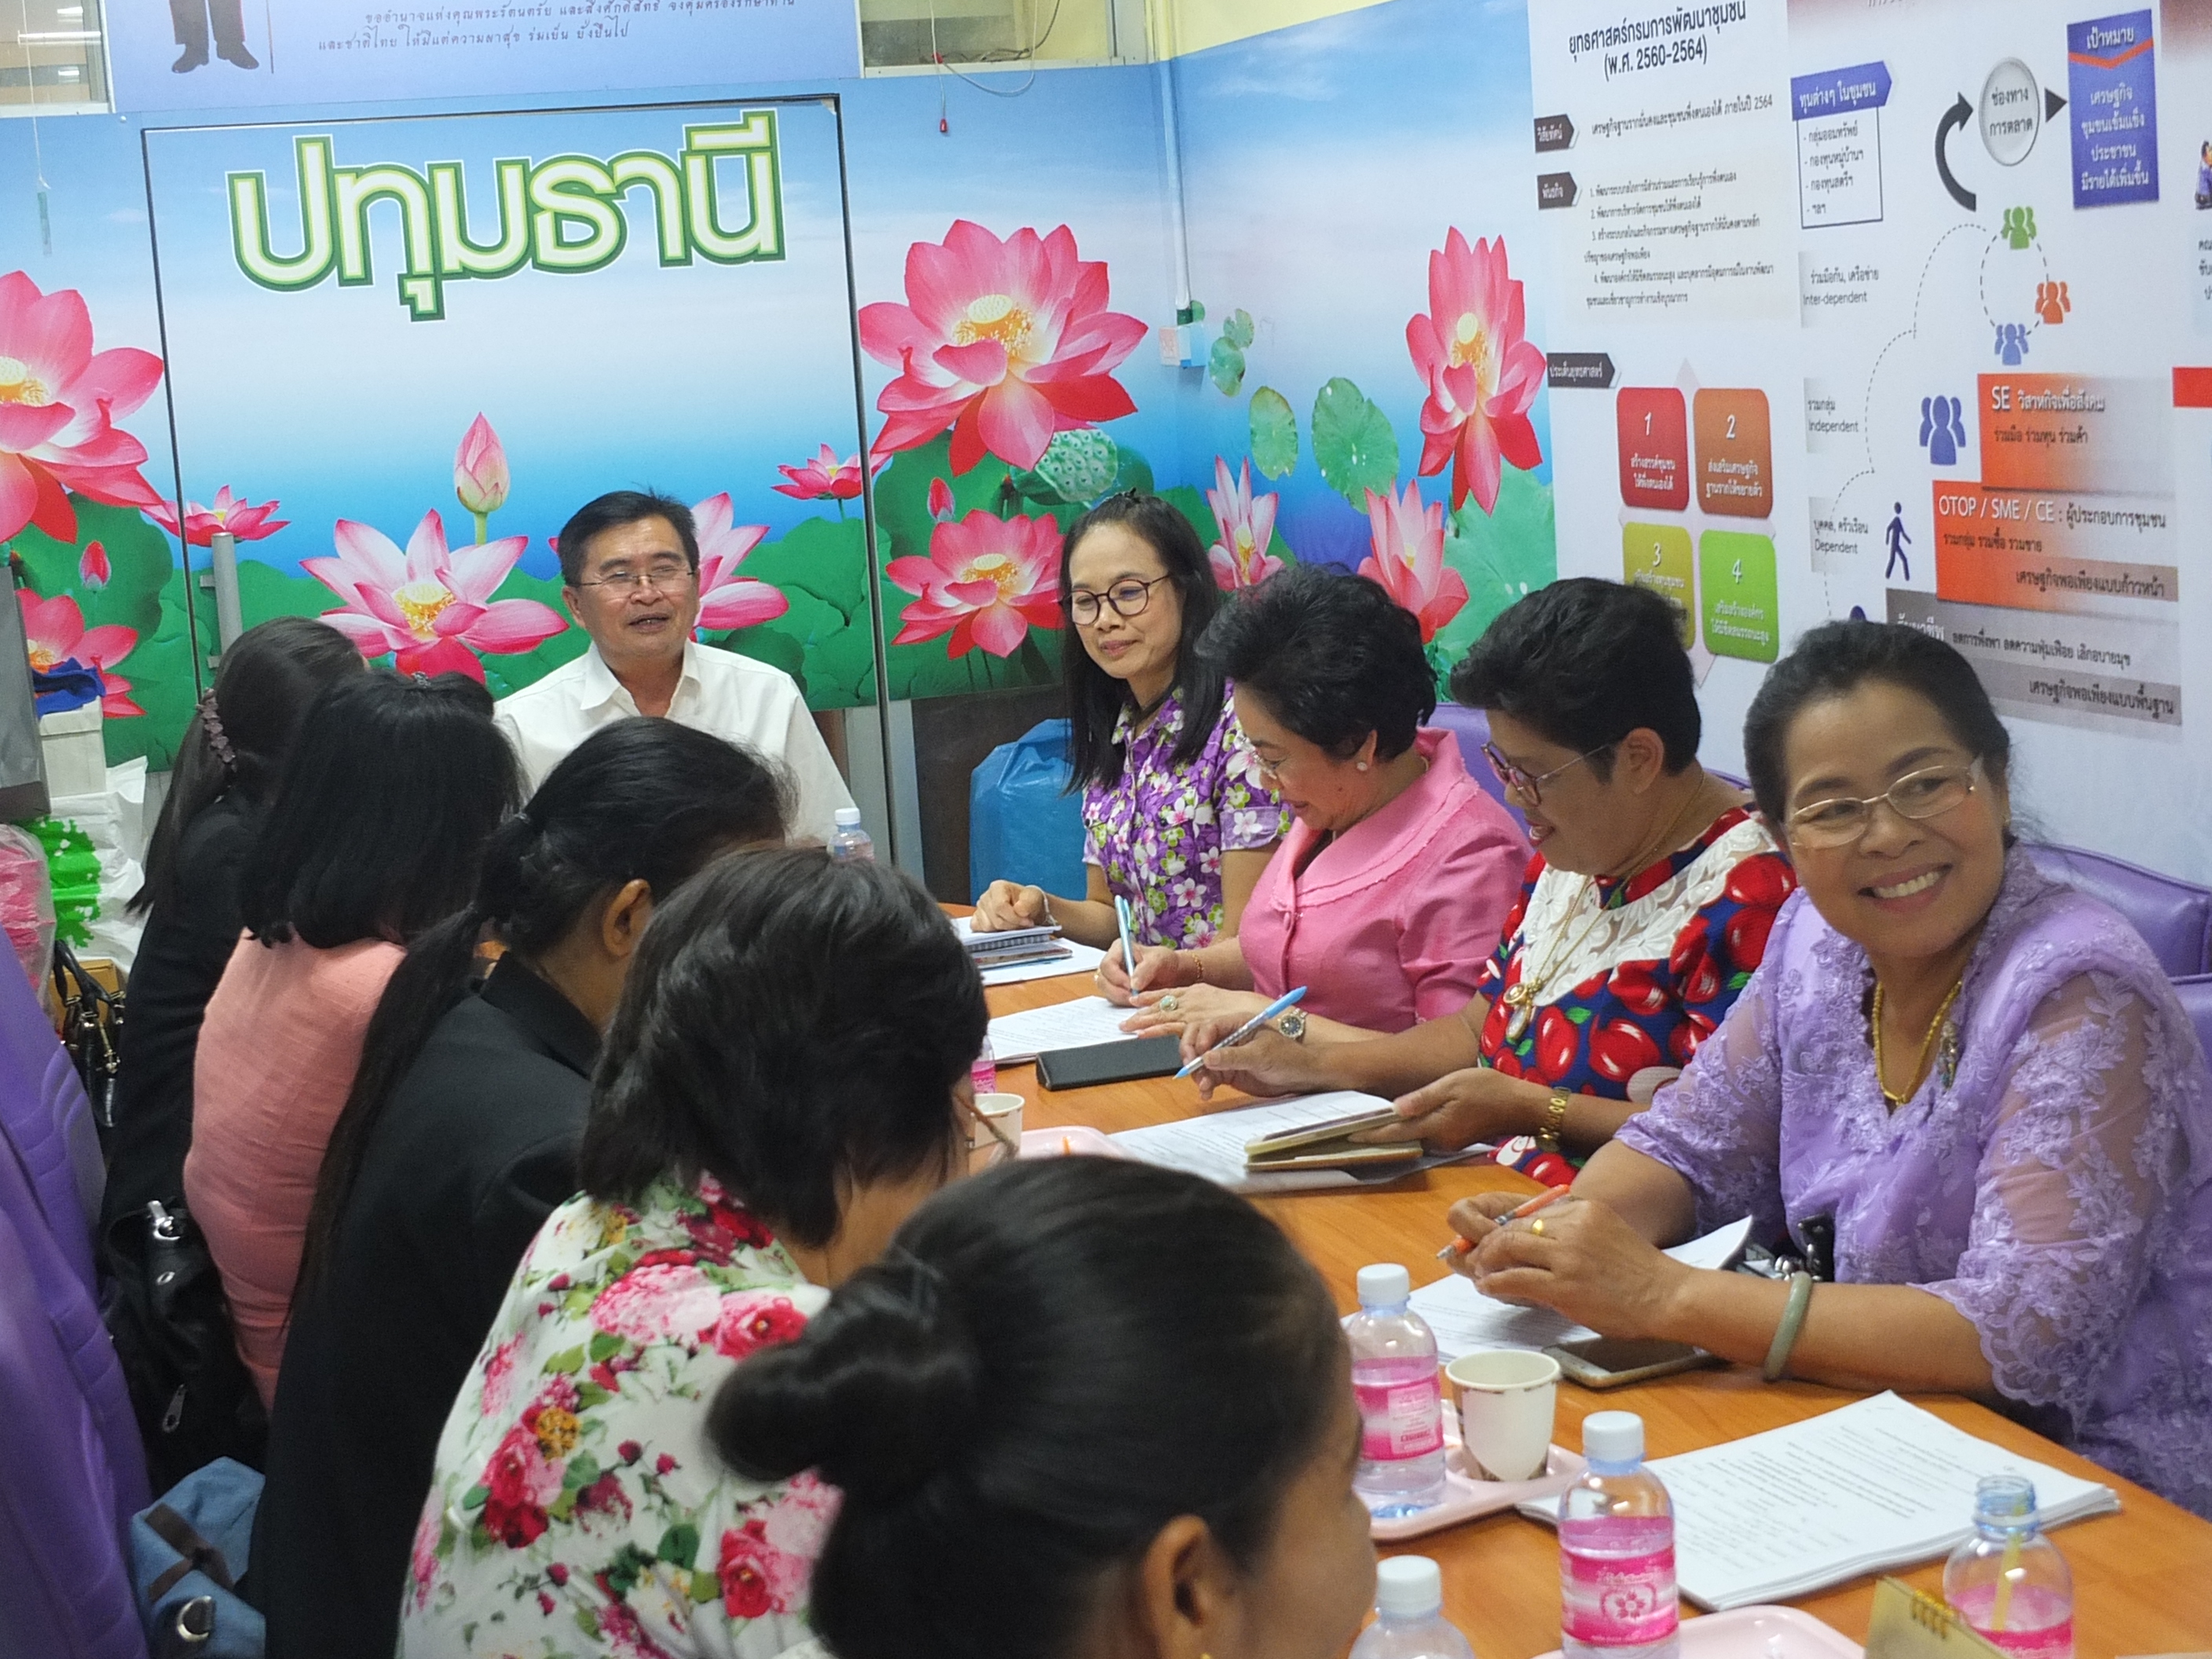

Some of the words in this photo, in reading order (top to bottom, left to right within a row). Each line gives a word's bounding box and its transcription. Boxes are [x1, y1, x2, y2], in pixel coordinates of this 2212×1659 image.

[1569, 0, 1746, 63] ยุทธศาสตร์กรมการพัฒนาชุมชน
[2086, 26, 2134, 49] เป้าหมาย
[1604, 52, 1633, 82] (พ.ศ.
[1636, 34, 1708, 71] 2560-2564)
[1754, 93, 1773, 110] 2564
[1837, 80, 1876, 106] ในชุมชน
[1991, 86, 2029, 106] ช่องทาง
[2089, 82, 2133, 108] เศรษฐกิจ
[1989, 117, 2033, 137] การตลาด
[2090, 143, 2137, 162] ประชาชน
[2081, 159, 2149, 192] มีรายได้เพิ่มขึ้น
[225, 109, 786, 322] ปทุมธานี
[1804, 290, 1868, 308] Inter-dependent
[1991, 386, 2011, 411] SE
[1644, 412, 1652, 436] 1
[1726, 414, 1736, 440] 2
[1807, 421, 1859, 434] Independent
[1938, 495, 1976, 518] OTOP
[1990, 498, 2020, 520] SME
[2035, 500, 2055, 522] CE
[2066, 502, 2166, 534] ผู้ประกอบการชุมชน
[1653, 542, 1662, 567] 3
[1815, 538, 1859, 556] Dependent
[1731, 558, 1742, 584] 4
